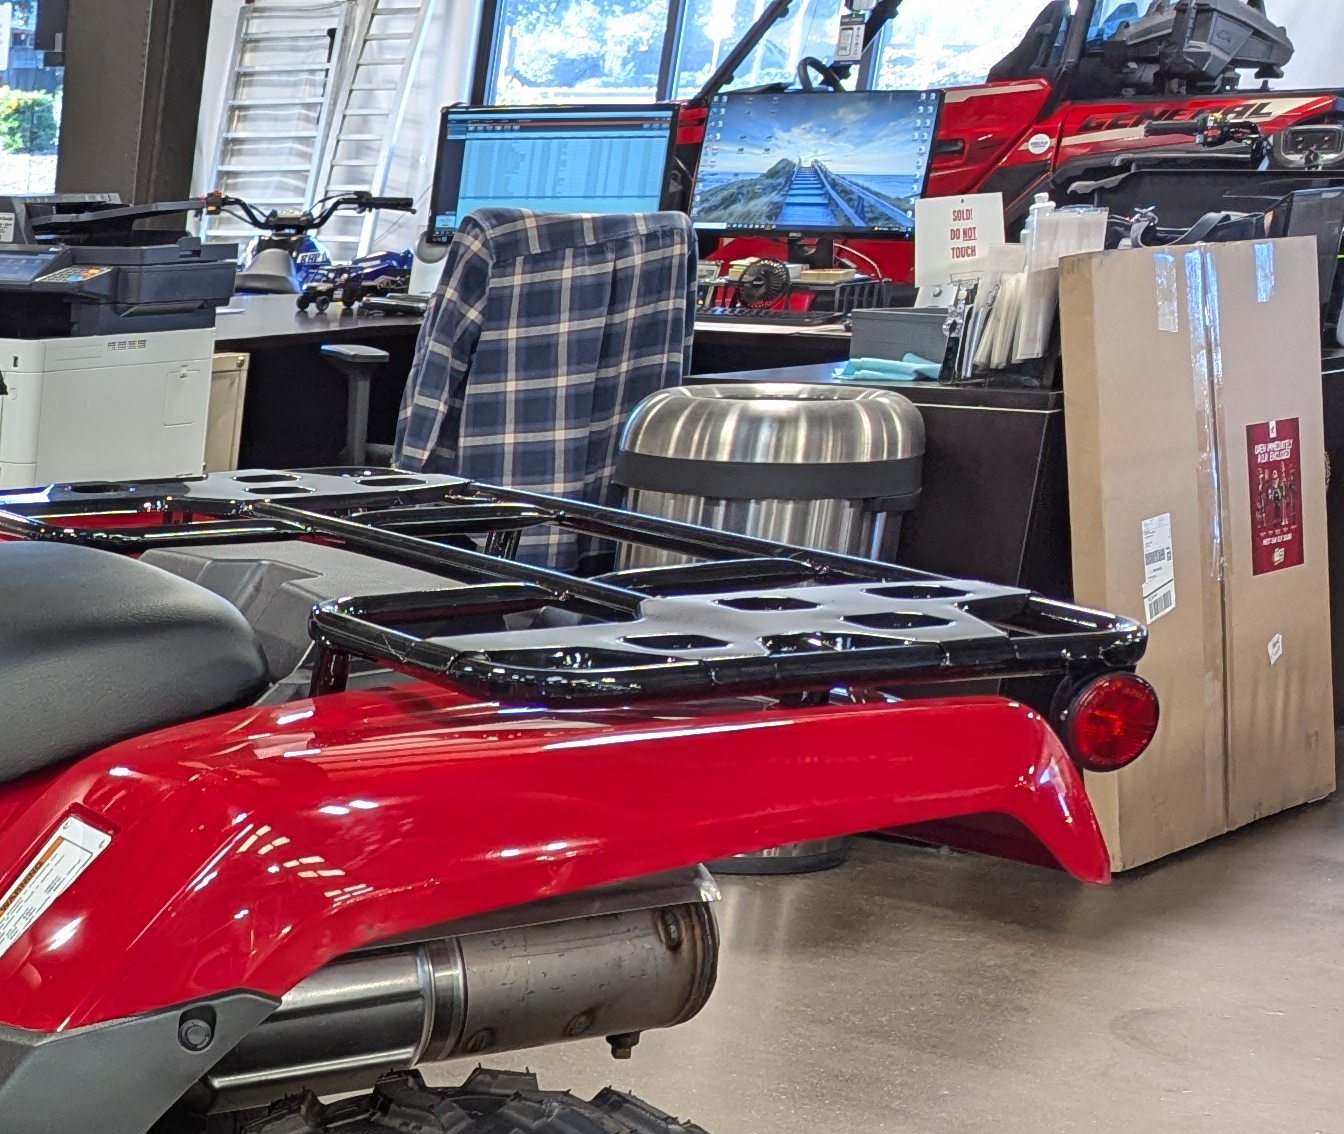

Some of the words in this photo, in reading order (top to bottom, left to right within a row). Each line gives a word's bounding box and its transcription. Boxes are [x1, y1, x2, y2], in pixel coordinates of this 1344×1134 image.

[952, 208, 973, 222] SOLD!
[950, 228, 961, 241] DO
[962, 226, 977, 241] NOT
[951, 244, 977, 259] TOUCH
[0, 861, 45, 912] WARNING
